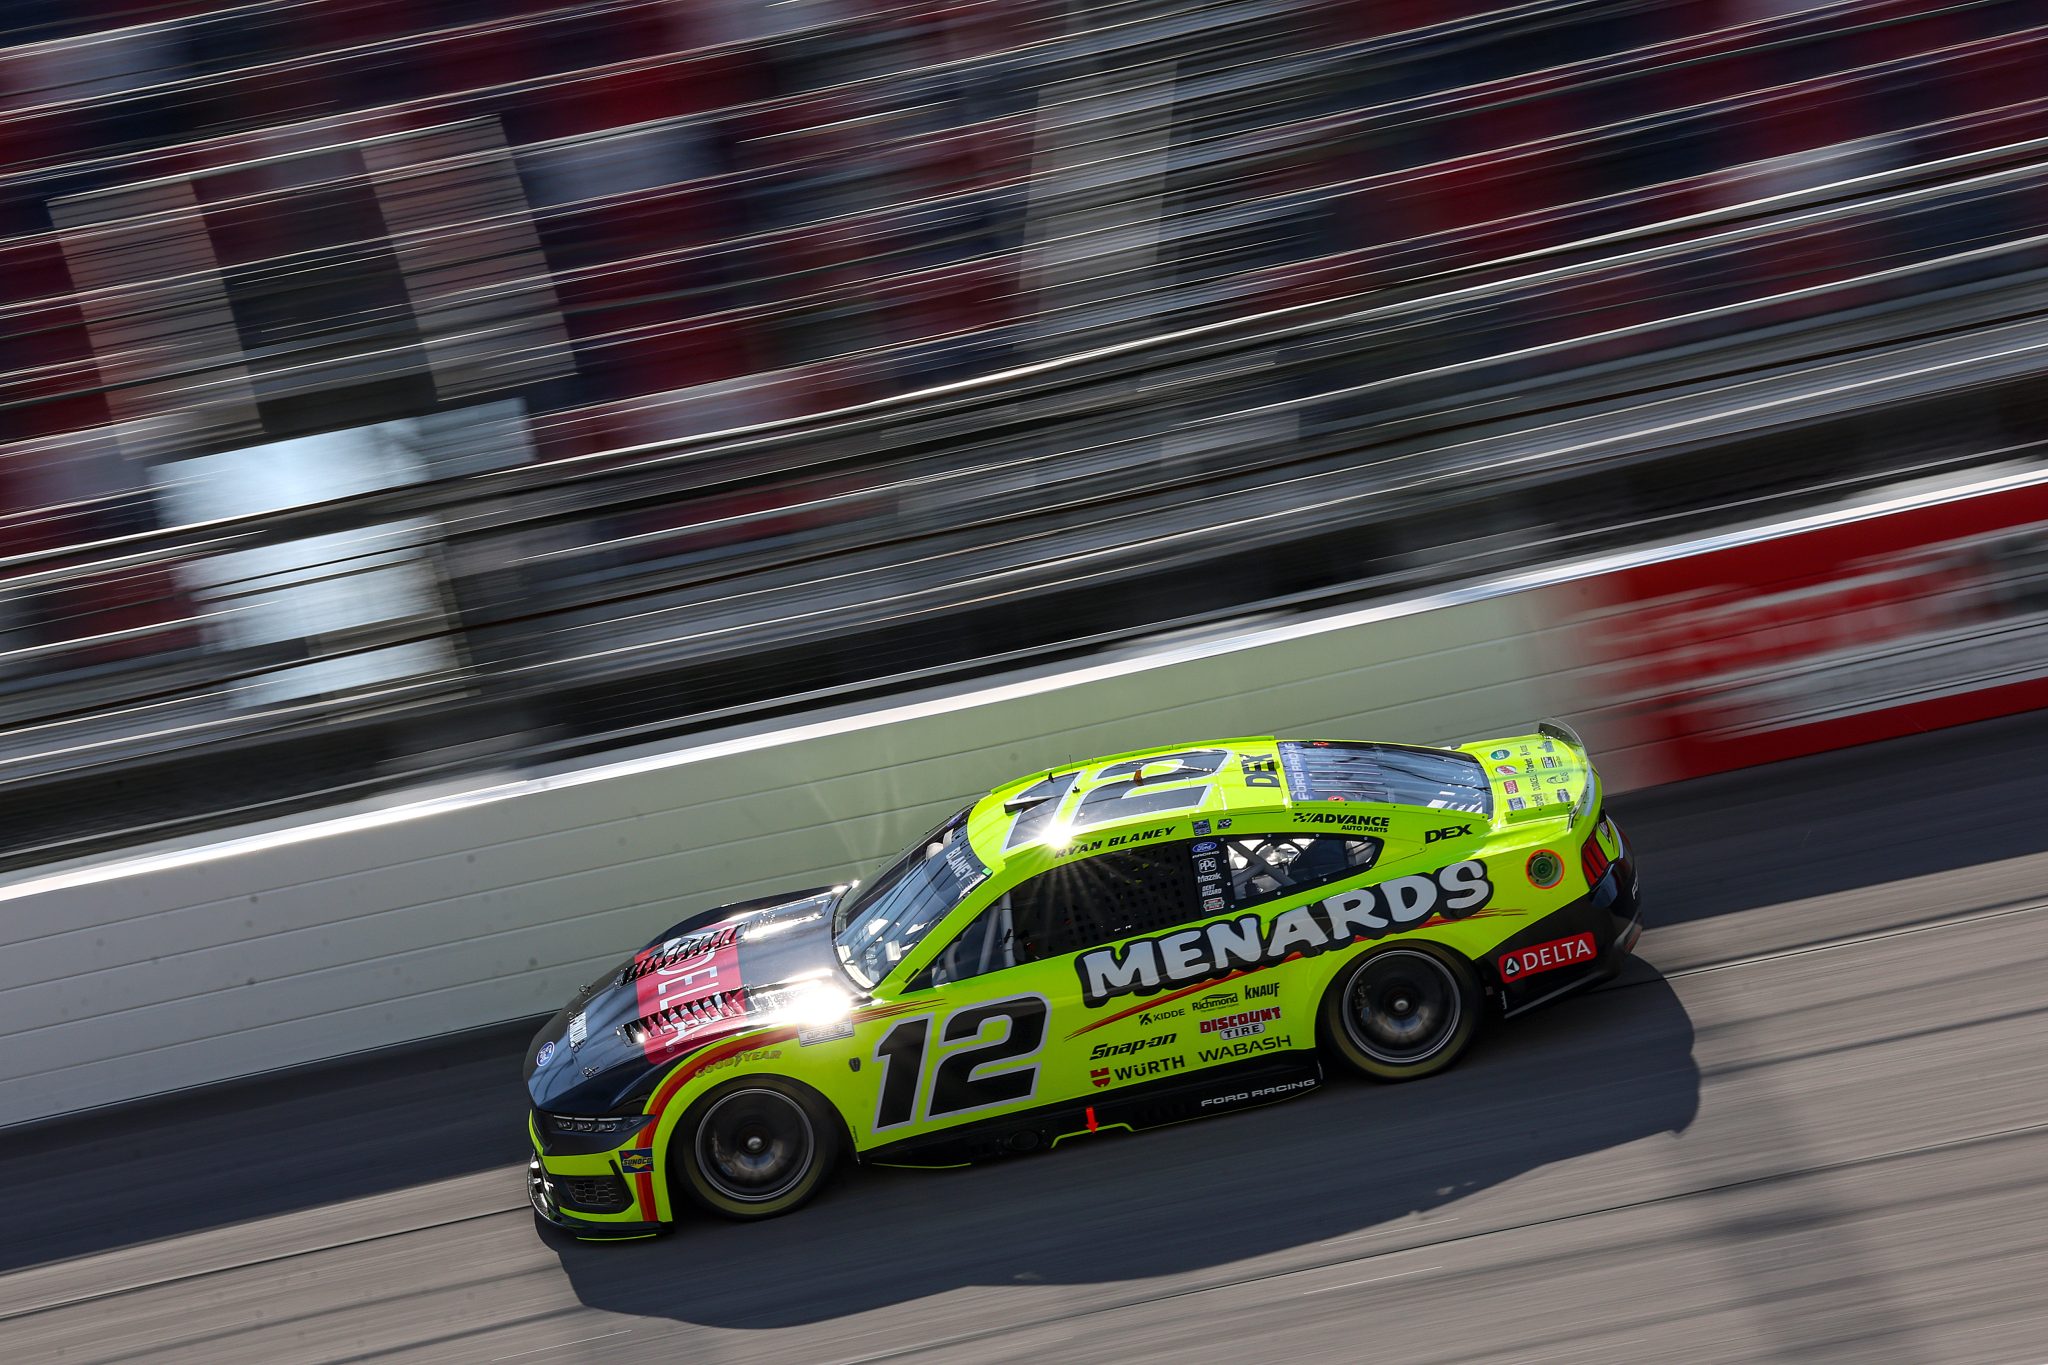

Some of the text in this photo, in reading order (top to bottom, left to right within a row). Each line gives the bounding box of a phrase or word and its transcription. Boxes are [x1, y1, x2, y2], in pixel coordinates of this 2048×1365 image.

[1239, 753, 1280, 788] DEX
[1310, 813, 1390, 827] ADVANCE
[1363, 825, 1388, 833] PARTS
[1055, 840, 1103, 859] RYAN
[1107, 826, 1176, 847] BLANEY
[1425, 824, 1473, 844] DEX
[945, 846, 977, 881] BLANEY
[1197, 873, 1222, 883] Mazak
[1081, 860, 1490, 1000] MENARDS
[1522, 939, 1592, 971] DELTA
[1192, 993, 1238, 1011] Richmond
[1245, 982, 1280, 1000] KNAUF
[1153, 1008, 1185, 1022] KIDDE
[1200, 1006, 1281, 1034] DISCOUNT
[1223, 1024, 1261, 1039] TIRE
[1089, 1033, 1178, 1060] Snap-on
[1198, 1035, 1292, 1062] WABASH
[872, 991, 1051, 1133] 12
[1115, 1055, 1185, 1081] WÜRTH
[1201, 1078, 1316, 1107] FORD RACING
[622, 1157, 653, 1167] SUNOCO
